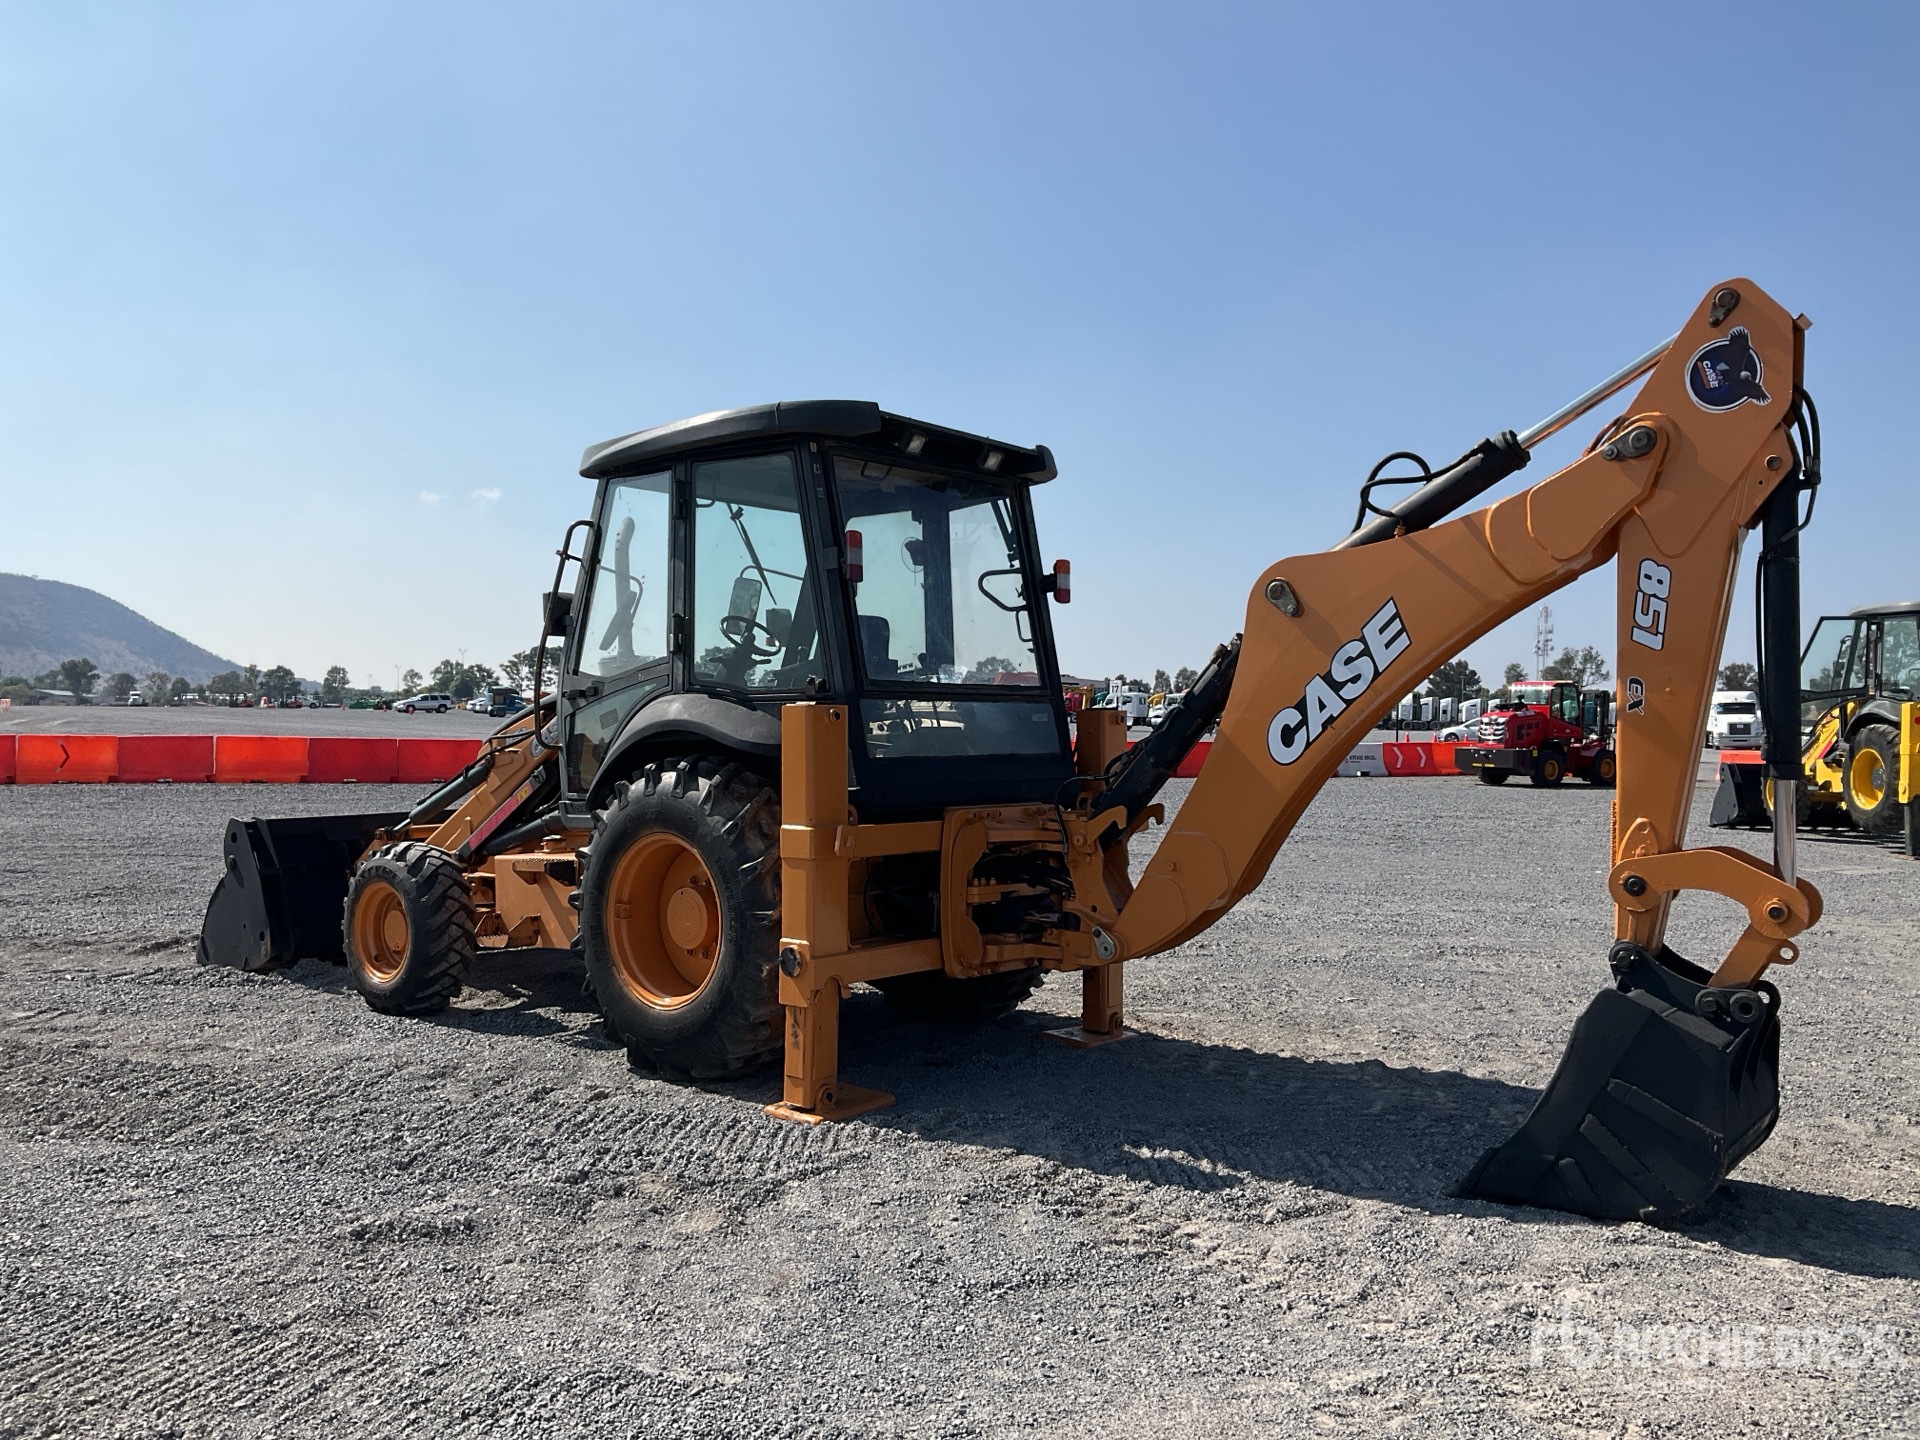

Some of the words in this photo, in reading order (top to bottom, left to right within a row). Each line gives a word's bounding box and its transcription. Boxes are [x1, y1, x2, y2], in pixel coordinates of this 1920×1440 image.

[1702, 360, 1718, 388] CASE
[1631, 558, 1672, 651] 851
[1267, 596, 1412, 766] CASE
[1627, 676, 1645, 715] EX
